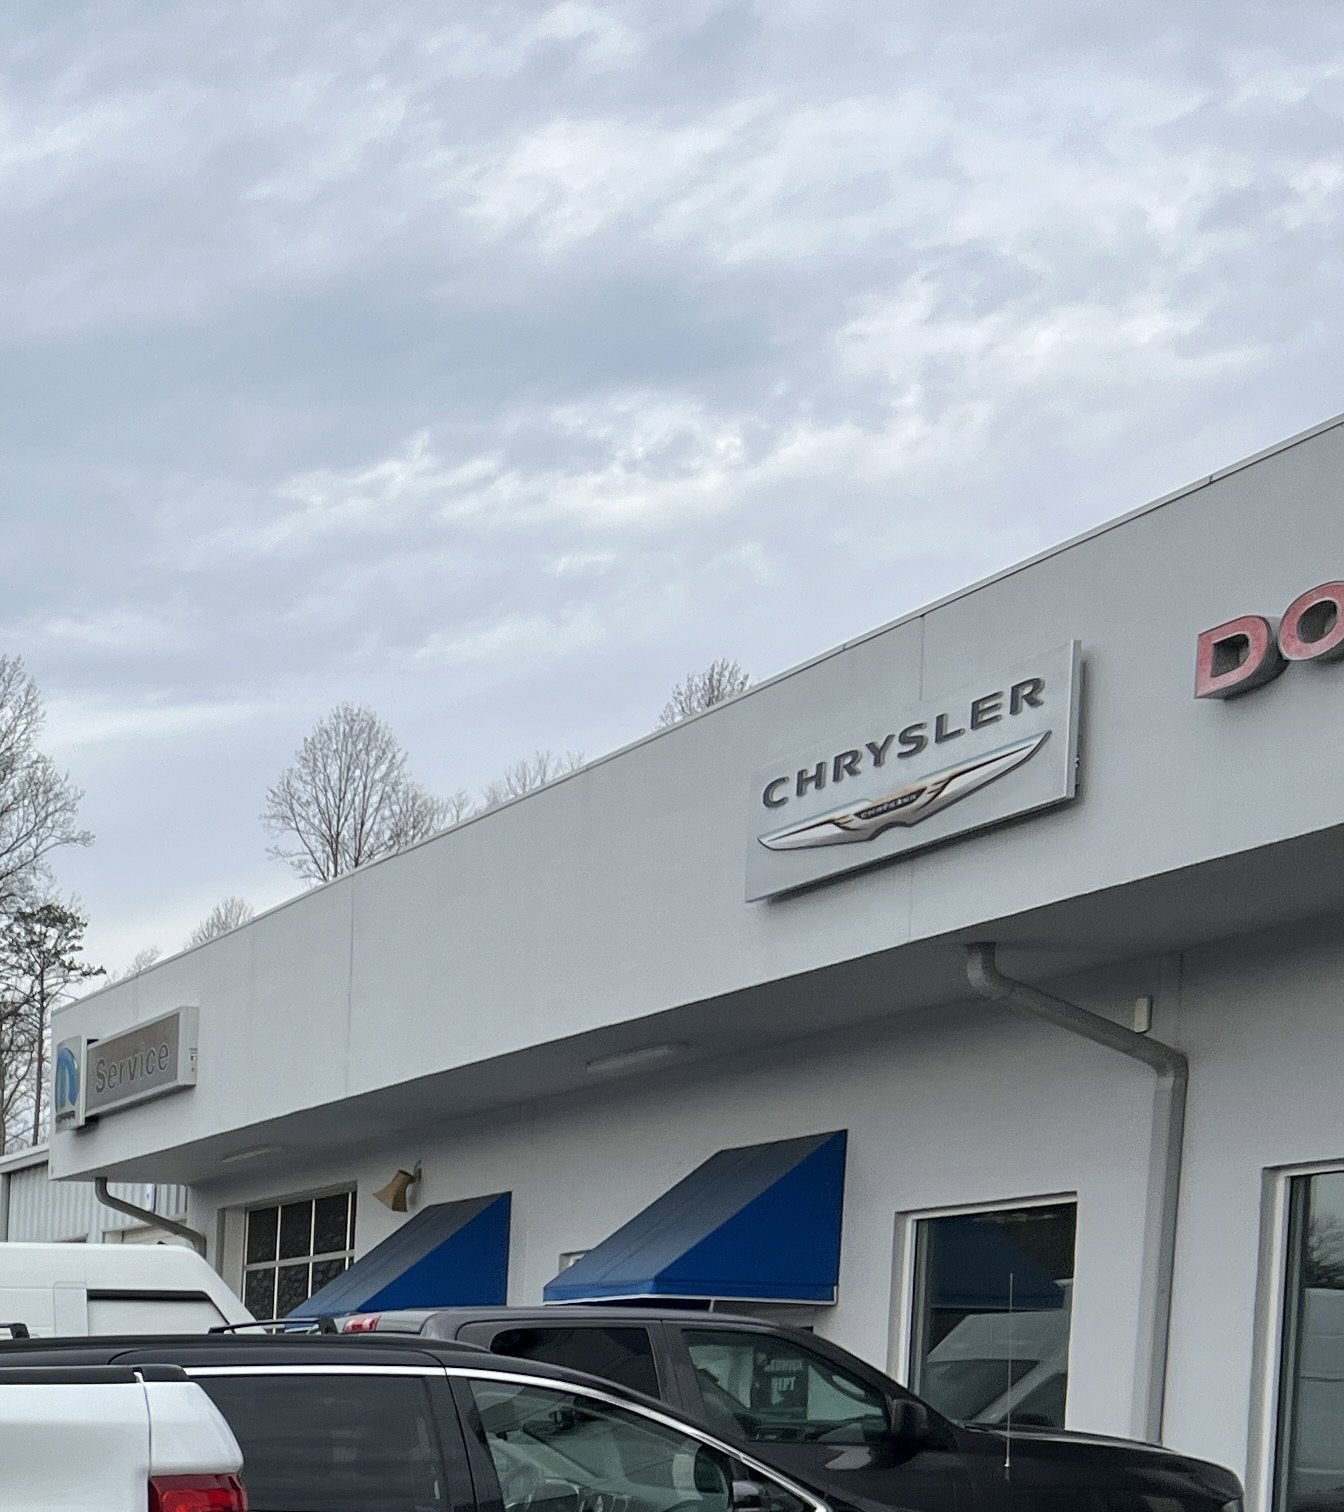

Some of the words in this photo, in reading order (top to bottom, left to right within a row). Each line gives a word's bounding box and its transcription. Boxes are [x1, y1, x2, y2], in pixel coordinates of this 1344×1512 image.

[1194, 580, 1344, 699] DO
[762, 677, 1047, 809] CHRYSLER
[96, 1043, 170, 1093] Service
